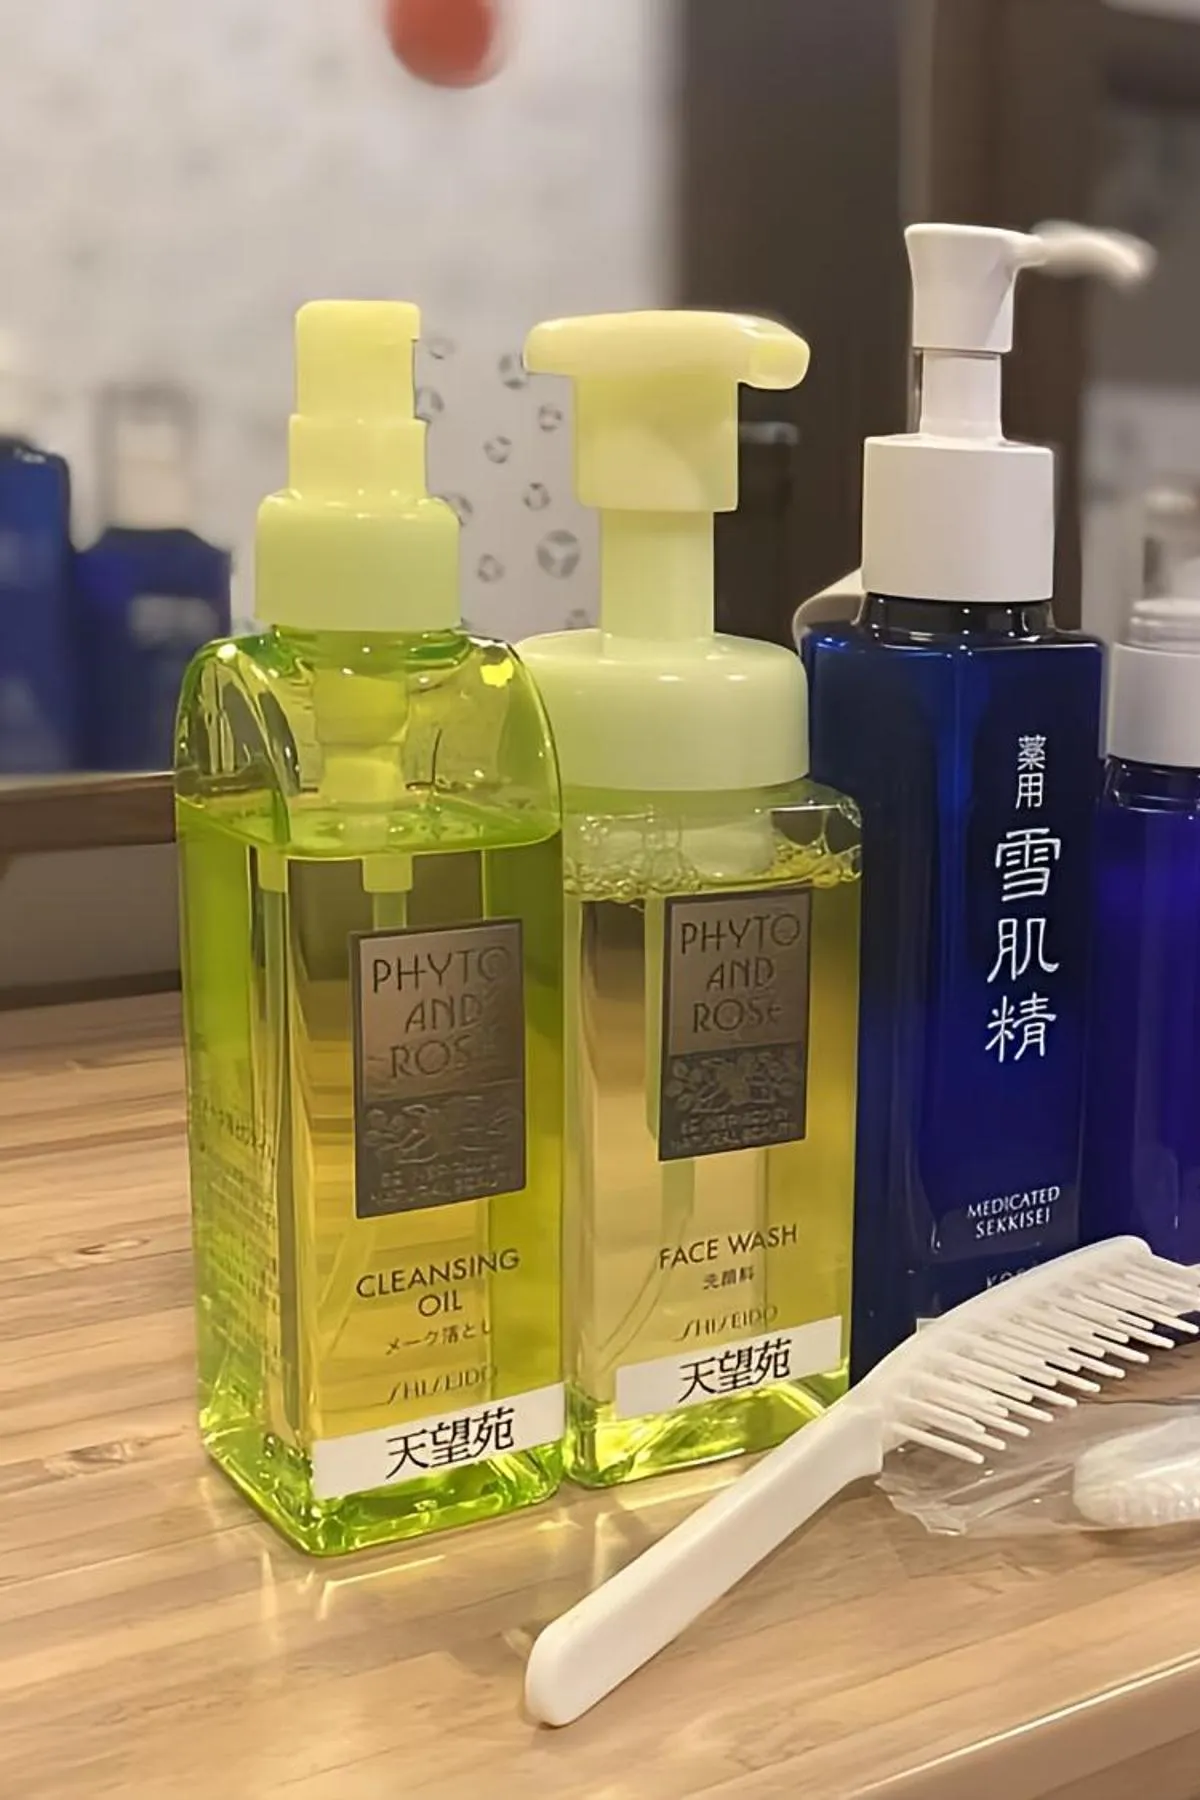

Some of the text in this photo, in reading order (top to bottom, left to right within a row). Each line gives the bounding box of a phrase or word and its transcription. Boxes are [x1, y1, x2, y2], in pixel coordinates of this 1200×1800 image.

[1016, 734, 1046, 809] 薬用
[679, 913, 801, 955] PHYTO
[985, 827, 1062, 1063] 雪肌精
[372, 945, 510, 993] PHYTO
[706, 956, 775, 992] AND
[404, 994, 483, 1034] AND
[692, 997, 783, 1034] ROSE
[967, 1184, 1061, 1219] MEDICATED
[974, 1204, 1052, 1239] SEKKISEI
[658, 1223, 798, 1270] FACE WASH
[355, 1248, 520, 1299] CLEANSING
[417, 1289, 463, 1317] OIL
[385, 1317, 491, 1356] メーク落とし
[677, 1337, 792, 1404] 天望苑
[384, 1405, 515, 1480] 天望苑
